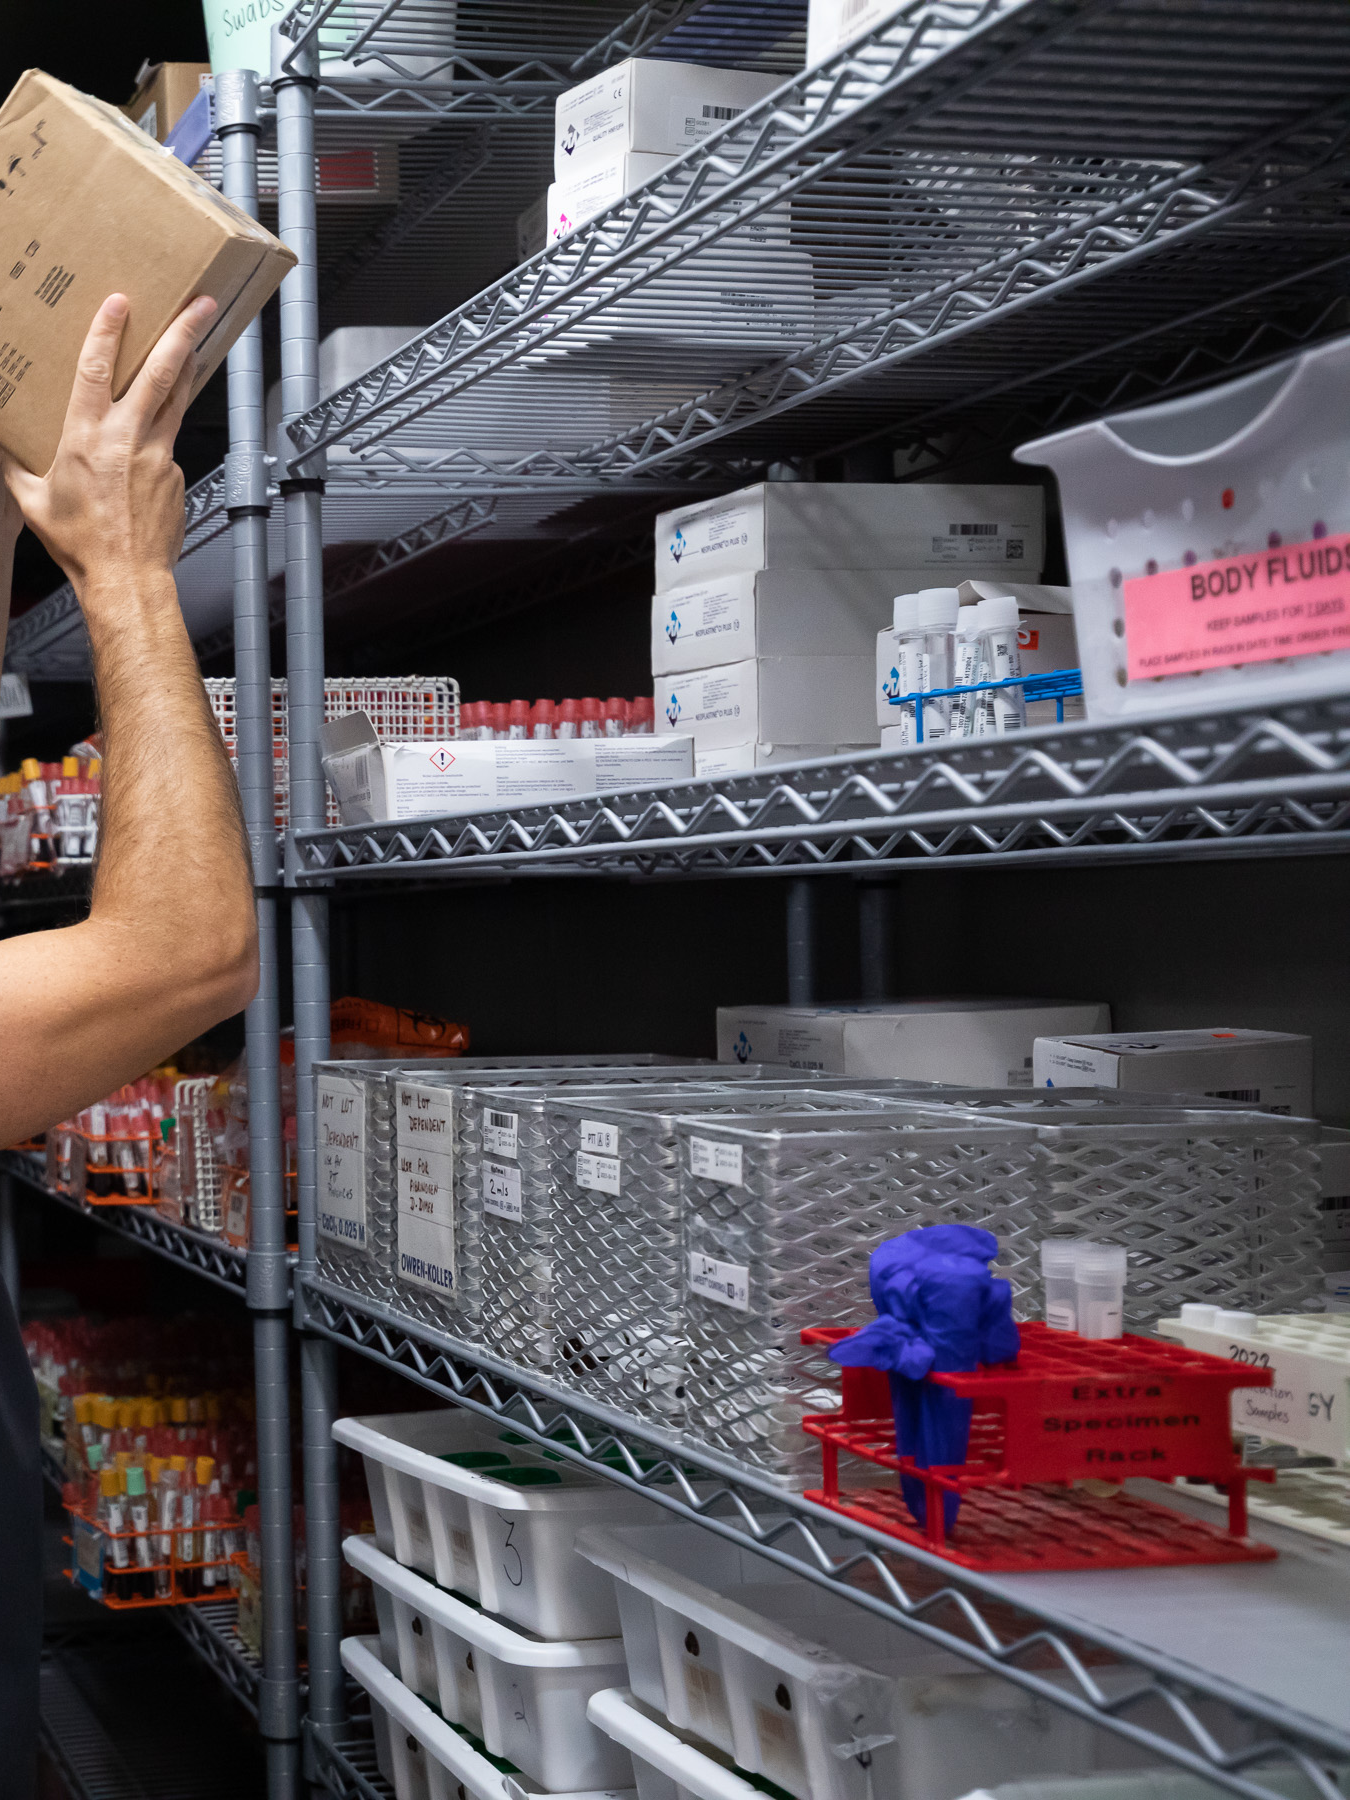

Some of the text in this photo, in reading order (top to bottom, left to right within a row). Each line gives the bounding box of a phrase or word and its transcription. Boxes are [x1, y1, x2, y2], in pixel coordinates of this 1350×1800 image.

[1191, 561, 1258, 601] BODY
[1207, 615, 1231, 632] KEEP
[1233, 609, 1280, 627] SAMPLES
[1282, 604, 1303, 619] FOR
[1139, 655, 1162, 667] PLACE
[1164, 649, 1200, 663] SAMPLES
[1273, 633, 1293, 646] TIME
[1296, 628, 1330, 643] ORDER
[321, 1093, 354, 1113] NOT LOT
[401, 1089, 430, 1110] NOT LOT
[324, 1123, 359, 1148] DEPENDENT
[408, 1114, 446, 1133] DEPENDENT
[338, 1219, 358, 1239] 0.025
[358, 1224, 365, 1242] M
[401, 1253, 454, 1290] OWREN-KOLLER
[1072, 1384, 1161, 1401] Extra
[1043, 1413, 1200, 1434] Specimen
[1245, 1399, 1290, 1424] Samples
[1085, 1448, 1166, 1463] Rack
[496, 1511, 523, 1586] 3
